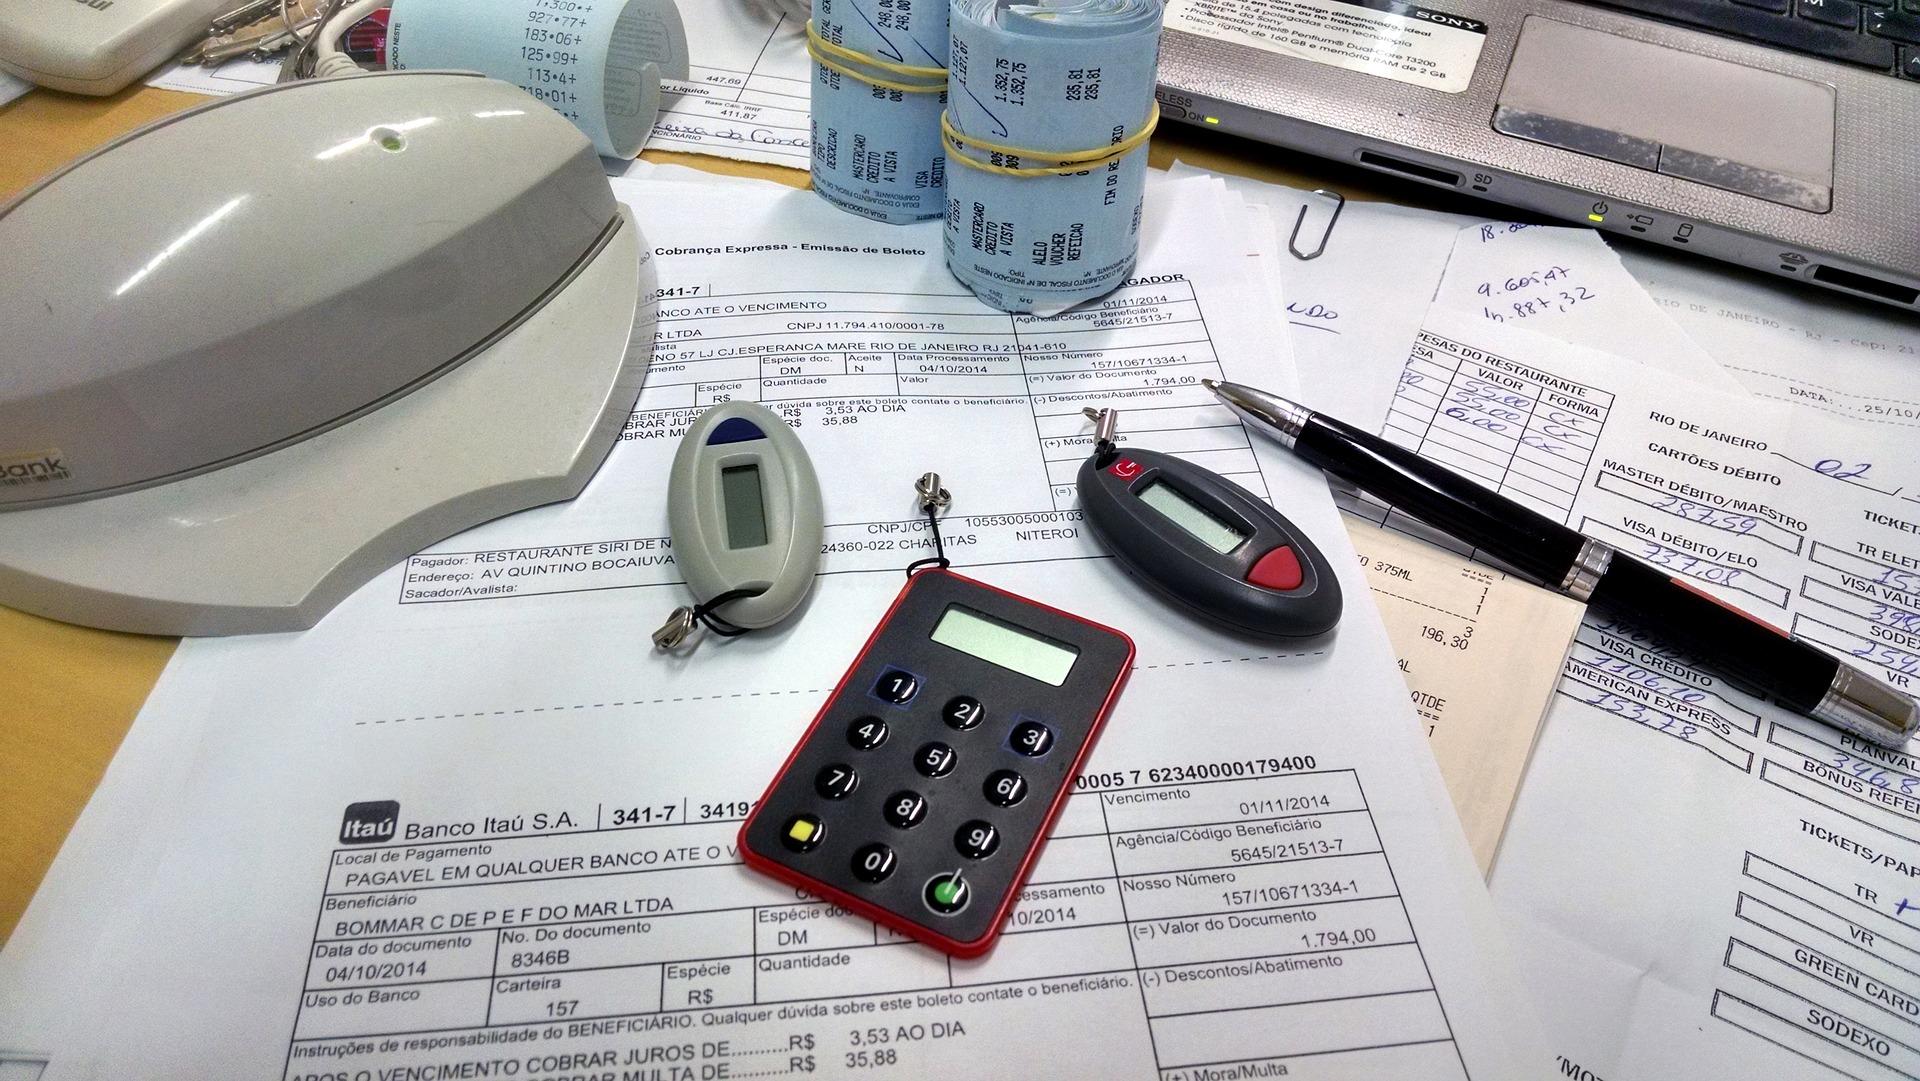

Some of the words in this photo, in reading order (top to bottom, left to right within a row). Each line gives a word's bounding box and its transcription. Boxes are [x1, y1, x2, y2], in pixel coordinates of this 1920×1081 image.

[1256, 14, 1283, 26] Sony
[1261, 10, 1321, 29] polegadas
[1324, 22, 1350, 33] com
[1294, 2, 1329, 14] design
[1403, 26, 1431, 37] ideal
[1330, 16, 1377, 32] trabalho.
[1415, 10, 1482, 31] SONY
[1185, 14, 1215, 26] Disco
[1270, 34, 1288, 43] 160
[1401, 64, 1417, 72] de
[1429, 70, 1447, 79] GB
[1405, 55, 1437, 68] T3200
[995, 58, 1009, 102] 1.352,75
[1011, 62, 1027, 106] 1.352,75
[1066, 69, 1083, 101] 235,81
[1085, 68, 1100, 100] 235,81
[1188, 112, 1205, 122] ON
[827, 128, 837, 170] DESCRICAO
[853, 134, 866, 180] MASTERCARD
[866, 152, 880, 183] CREDITO
[884, 151, 898, 170] VISTA
[915, 171, 929, 189] VISA
[931, 157, 945, 188] CREDITO
[1106, 174, 1118, 188] DO
[1474, 173, 1493, 186] SD
[1104, 190, 1116, 205] FIM
[972, 202, 985, 250] MASTERCARD
[1001, 222, 1014, 243] VISTA
[985, 221, 998, 256] CREDITO
[1067, 223, 1083, 261] REFEICAO
[655, 246, 721, 257] Cobrança
[725, 243, 788, 254] Expressa
[801, 243, 858, 254] Emissão
[862, 246, 879, 255] de
[883, 247, 926, 256] Boleto
[1032, 241, 1048, 266] ALELO
[1050, 233, 1066, 266] VOUCHER
[655, 286, 701, 298] 341-7
[1103, 295, 1168, 309] 01/11/2014
[738, 301, 828, 313] VENCIMENTO
[787, 322, 822, 331] CNPJ
[1093, 313, 1173, 328] 5645/21513-7
[1717, 308, 1780, 329] JANEIRO
[921, 342, 979, 351] JANEIRO
[848, 354, 882, 362] Aceite
[1090, 355, 1188, 369] 157/10671334-1
[780, 366, 801, 375] DM
[919, 365, 988, 374] 04/10/2014
[1095, 369, 1157, 380] Documento
[1461, 348, 1482, 361] DO
[1485, 356, 1588, 397] RESTAURANTE
[697, 382, 742, 394] Espécie
[763, 377, 828, 388] Quantidade
[1143, 376, 1196, 387] 1.794,00
[1049, 388, 1173, 404] Descontos/Abatimento
[1478, 367, 1524, 391] VALOR
[1548, 394, 1600, 418] FORMA
[822, 416, 858, 426] 35,88
[1649, 410, 1676, 426] RIO
[1678, 421, 1700, 435] DE
[1701, 427, 1769, 452] JANEIRO
[1648, 441, 1719, 473] CARTÕES
[1722, 461, 1782, 487] DÉBITO
[1603, 458, 1665, 488] MASTER
[1668, 475, 1808, 533] DÉBITO/MAESTRO
[965, 511, 1084, 528] 10553005000103
[820, 540, 894, 554] 24360-022
[1016, 528, 1079, 542] NITEROI
[1623, 516, 1656, 538] VISA
[1661, 529, 1758, 569] DÉBITO/ELO
[1856, 541, 1877, 557] TR
[411, 556, 468, 569] Pagador:
[474, 544, 593, 563] RESTAURANTE
[598, 541, 629, 553] SIRI
[634, 539, 656, 550] DE
[408, 571, 475, 584] Endereço:
[481, 568, 504, 579] AV
[507, 562, 587, 577] QUINTINO
[592, 554, 676, 571] BOCAIUVA
[1374, 560, 1413, 582] 375ML
[405, 583, 518, 599] Sacador/Avalista:
[1840, 574, 1877, 596] VISA
[1420, 625, 1469, 651] 196,30
[1463, 626, 1474, 638] 3
[1599, 636, 1636, 659] VISA
[1886, 671, 1909, 688] VR
[1564, 661, 1650, 702] AMERICAN
[1654, 692, 1731, 735] EXPRESS
[892, 678, 902, 694] 1
[953, 703, 969, 719] 2
[1022, 729, 1037, 746] 3
[858, 723, 872, 738] 4
[927, 750, 940, 766] 5
[997, 779, 1011, 794] 6
[1104, 787, 1191, 806] Vencimento
[1239, 795, 1331, 816] 01/11/2014
[613, 805, 676, 826] 341-7
[828, 770, 845, 786] 7
[896, 799, 911, 816] 8
[968, 829, 982, 846] 9
[404, 823, 476, 841] Banco
[483, 815, 524, 834] Itaú
[335, 852, 377, 866] Local
[405, 844, 492, 863] Pagamento
[865, 852, 881, 870] 0
[1230, 838, 1344, 864] 5645/21513-7
[345, 868, 435, 888] PAGAVEL
[441, 865, 470, 880] EM
[475, 856, 584, 879] QUALQUER
[590, 850, 658, 869] BANCO
[1123, 877, 1172, 893] Nosso
[1222, 880, 1359, 907] 157/10671334-1
[1854, 883, 1878, 904] TR
[335, 916, 424, 937] BOMMAR
[450, 912, 478, 929] DE
[539, 905, 568, 921] DO
[574, 901, 617, 919] MAR
[623, 897, 674, 915] LTDA
[1160, 920, 1200, 937] Valor
[1229, 909, 1317, 930] Documento
[563, 920, 651, 940] documento
[777, 930, 808, 945] DM
[1301, 927, 1377, 949] 1.794,00
[1849, 925, 1875, 947] VR
[383, 936, 472, 955] documento
[511, 950, 570, 968] 8346B
[758, 953, 850, 972] Quantidade
[1165, 954, 1344, 985] Descontos/Abatimento
[326, 961, 427, 983] 04/10/2014
[1795, 948, 1859, 989] GREEN
[1865, 982, 1920, 1016] CARD
[496, 976, 562, 994] Carteira
[546, 1000, 579, 1018] 157
[404, 1028, 538, 1054] responsabilidade
[850, 1027, 889, 1047] 3,53
[1807, 1009, 1891, 1057] SODEXO
[526, 1052, 617, 1076] COBRAR
[624, 1045, 696, 1065] JUROS
[845, 1049, 897, 1068] 35,88
